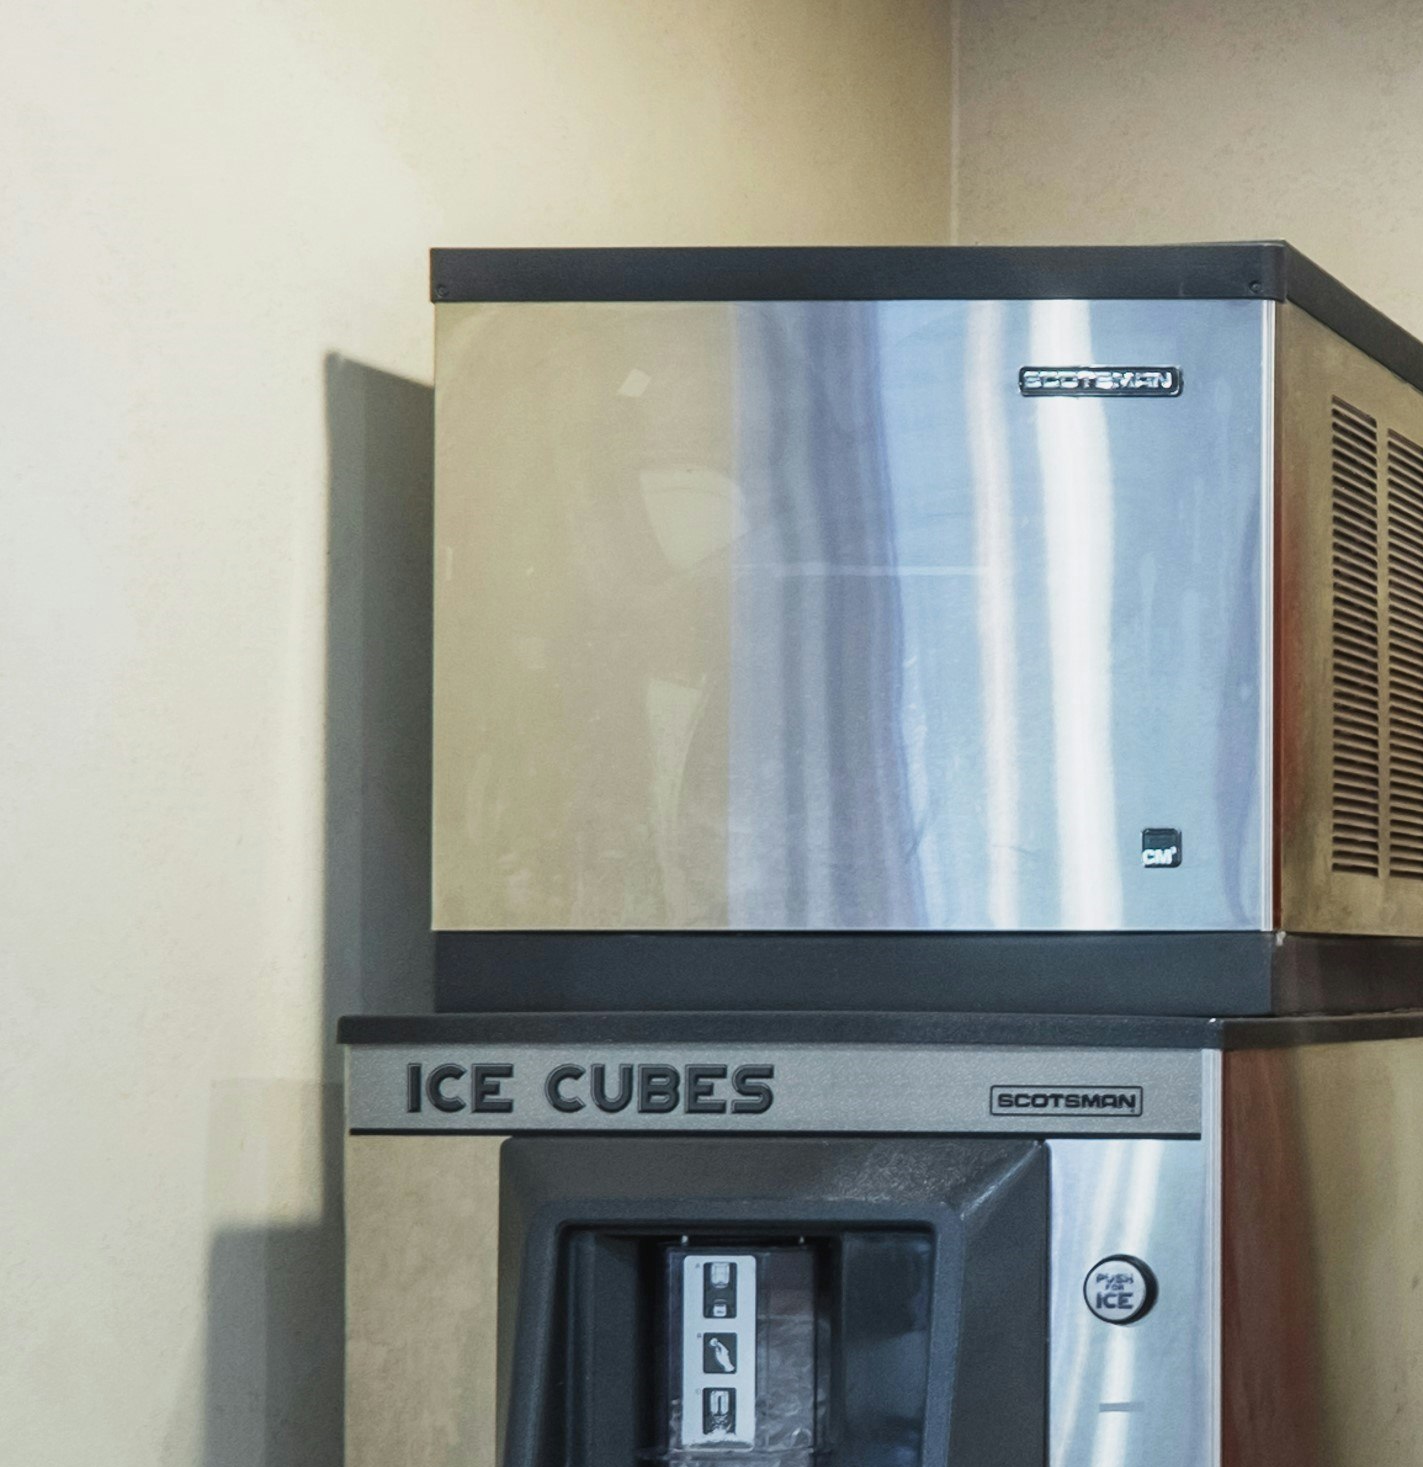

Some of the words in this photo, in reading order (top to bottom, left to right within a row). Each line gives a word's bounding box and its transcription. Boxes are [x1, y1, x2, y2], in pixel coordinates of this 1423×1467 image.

[407, 1062, 514, 1114] ICE
[544, 1062, 775, 1114] CUBES
[998, 1093, 1136, 1108] SCOTSMAN
[1096, 1292, 1134, 1310] ICE
